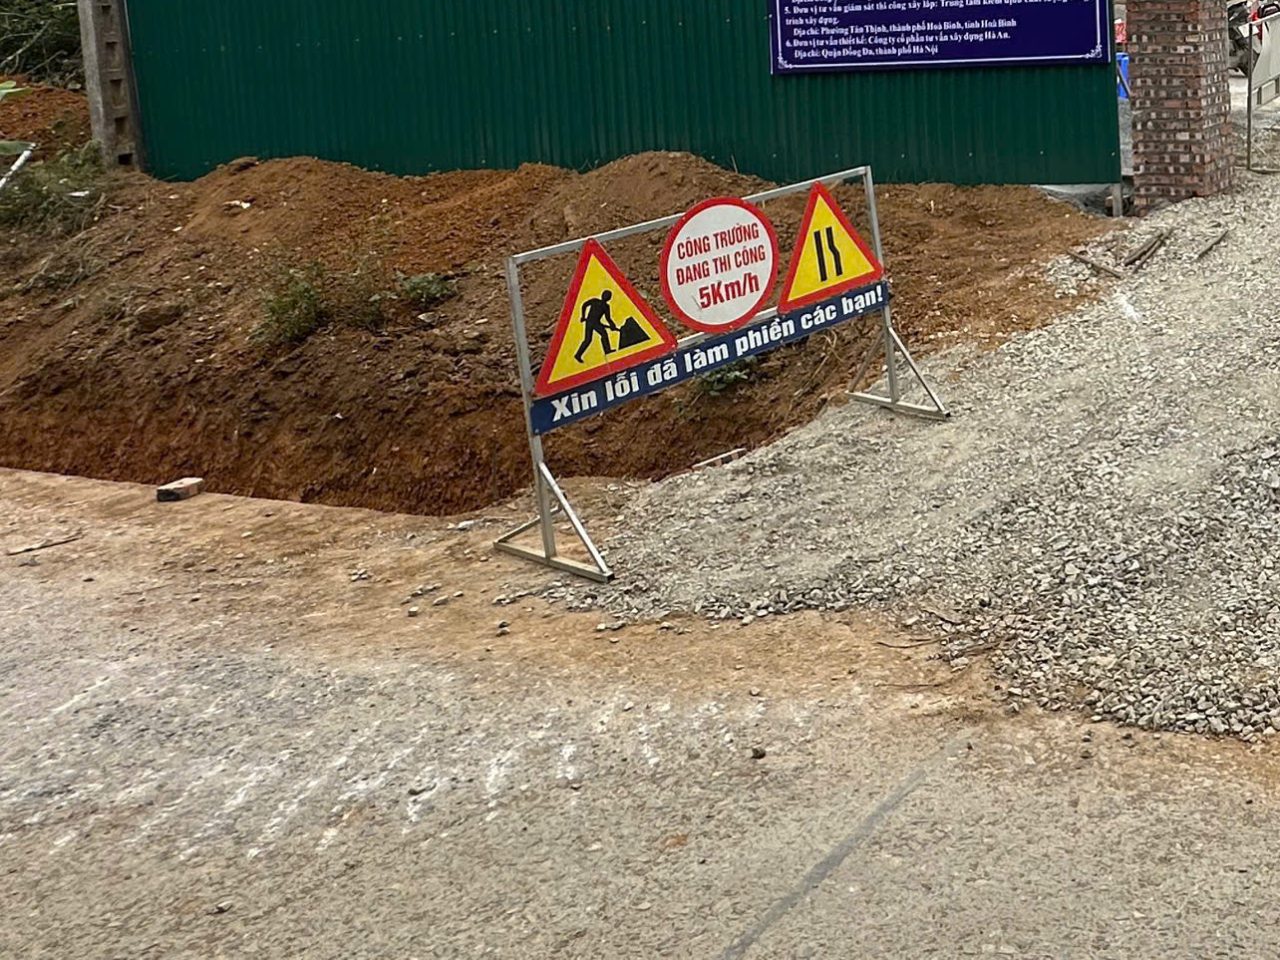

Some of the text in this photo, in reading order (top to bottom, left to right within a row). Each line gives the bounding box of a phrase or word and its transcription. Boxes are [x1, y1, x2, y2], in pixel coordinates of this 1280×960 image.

[677, 222, 759, 260] CÔNG TRƯỜNG
[676, 245, 766, 286] ĐANG THI CÔNG
[699, 272, 760, 309] 5Km/h
[550, 285, 884, 422] Xin lỗi đã làm phiền các bạn!
